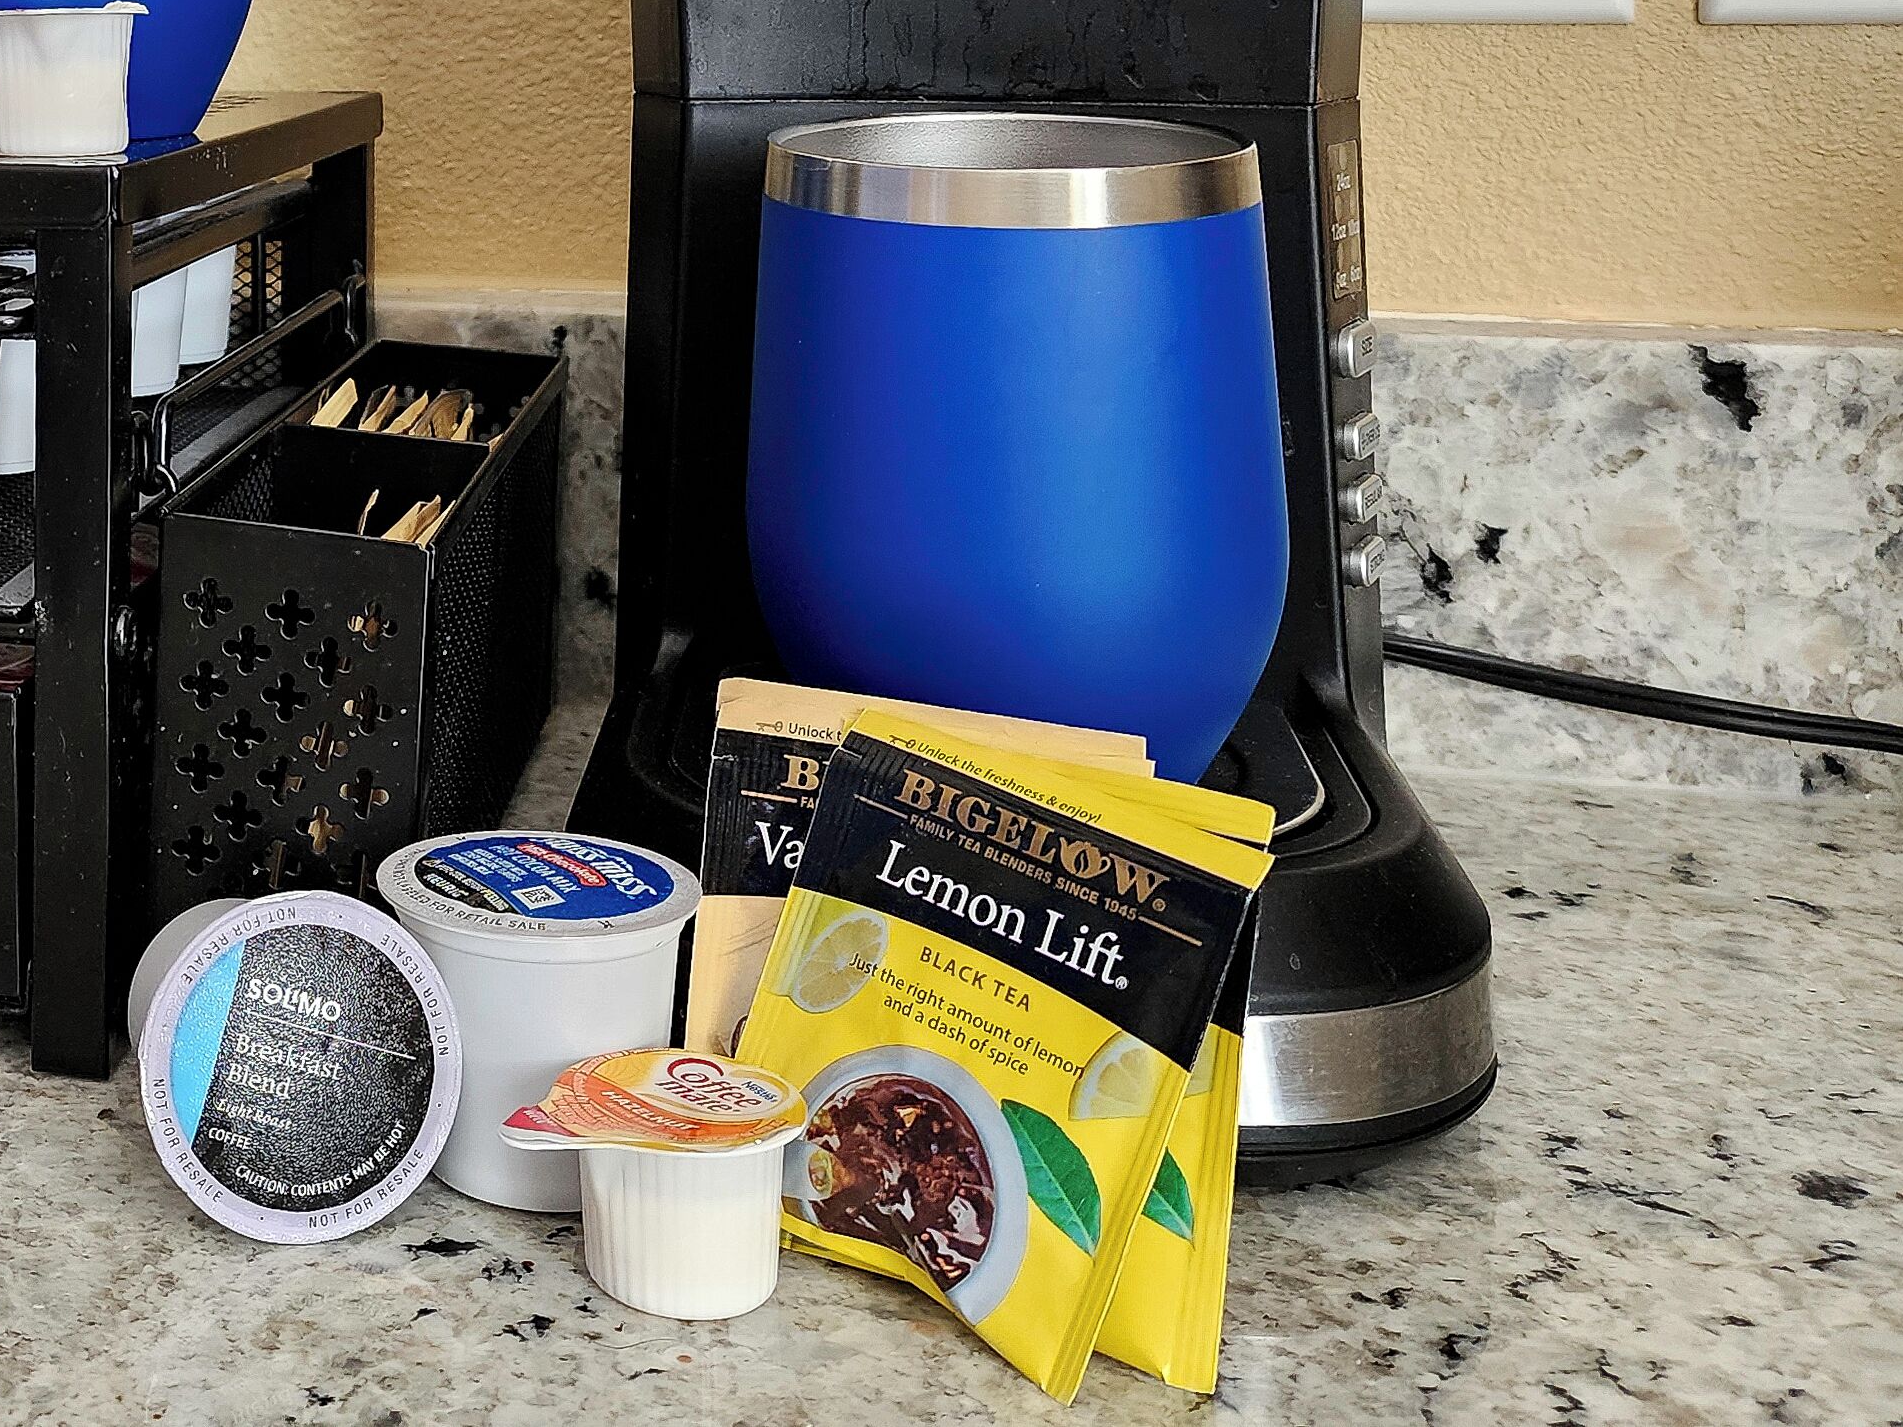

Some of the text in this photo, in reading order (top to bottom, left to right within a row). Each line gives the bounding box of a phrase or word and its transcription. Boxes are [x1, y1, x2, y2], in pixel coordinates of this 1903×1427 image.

[788, 722, 833, 741] Unlock
[917, 743, 1103, 824] Unlock the freshness & enjoy!
[894, 768, 1171, 904] BIGELOW
[909, 813, 1138, 922] FAMILY TEA BLENDERS SINCE 1945
[424, 873, 463, 898] KEURIG
[512, 854, 556, 878] COCOA
[546, 874, 582, 894] MIX
[180, 906, 297, 985] NOT FOR RESALE
[429, 900, 455, 914] FOR
[454, 910, 504, 928] RETAIL
[507, 919, 547, 932] SALE
[875, 838, 1126, 986] Lemon Lift
[380, 933, 450, 1057] NOT FOR RESALE
[919, 946, 1031, 1013] BLACK TEA
[848, 953, 1086, 1080] Just the right amount of lemon
[883, 994, 1030, 1076] and a dash of spice
[227, 1062, 292, 1100] Blend
[234, 1033, 345, 1081] Breakfast
[667, 1057, 763, 1108] Coffee
[215, 1097, 294, 1129] Light Roast
[601, 1090, 700, 1130] HAZELNUT
[655, 1079, 733, 1112] mate
[153, 1078, 224, 1203] NOT FOR RESALE
[208, 1127, 251, 1150] COFFEE
[235, 1121, 407, 1197] CAUTION: CONTENTS MAY BE HOT
[308, 1148, 425, 1229] NOT FOR RESALE
